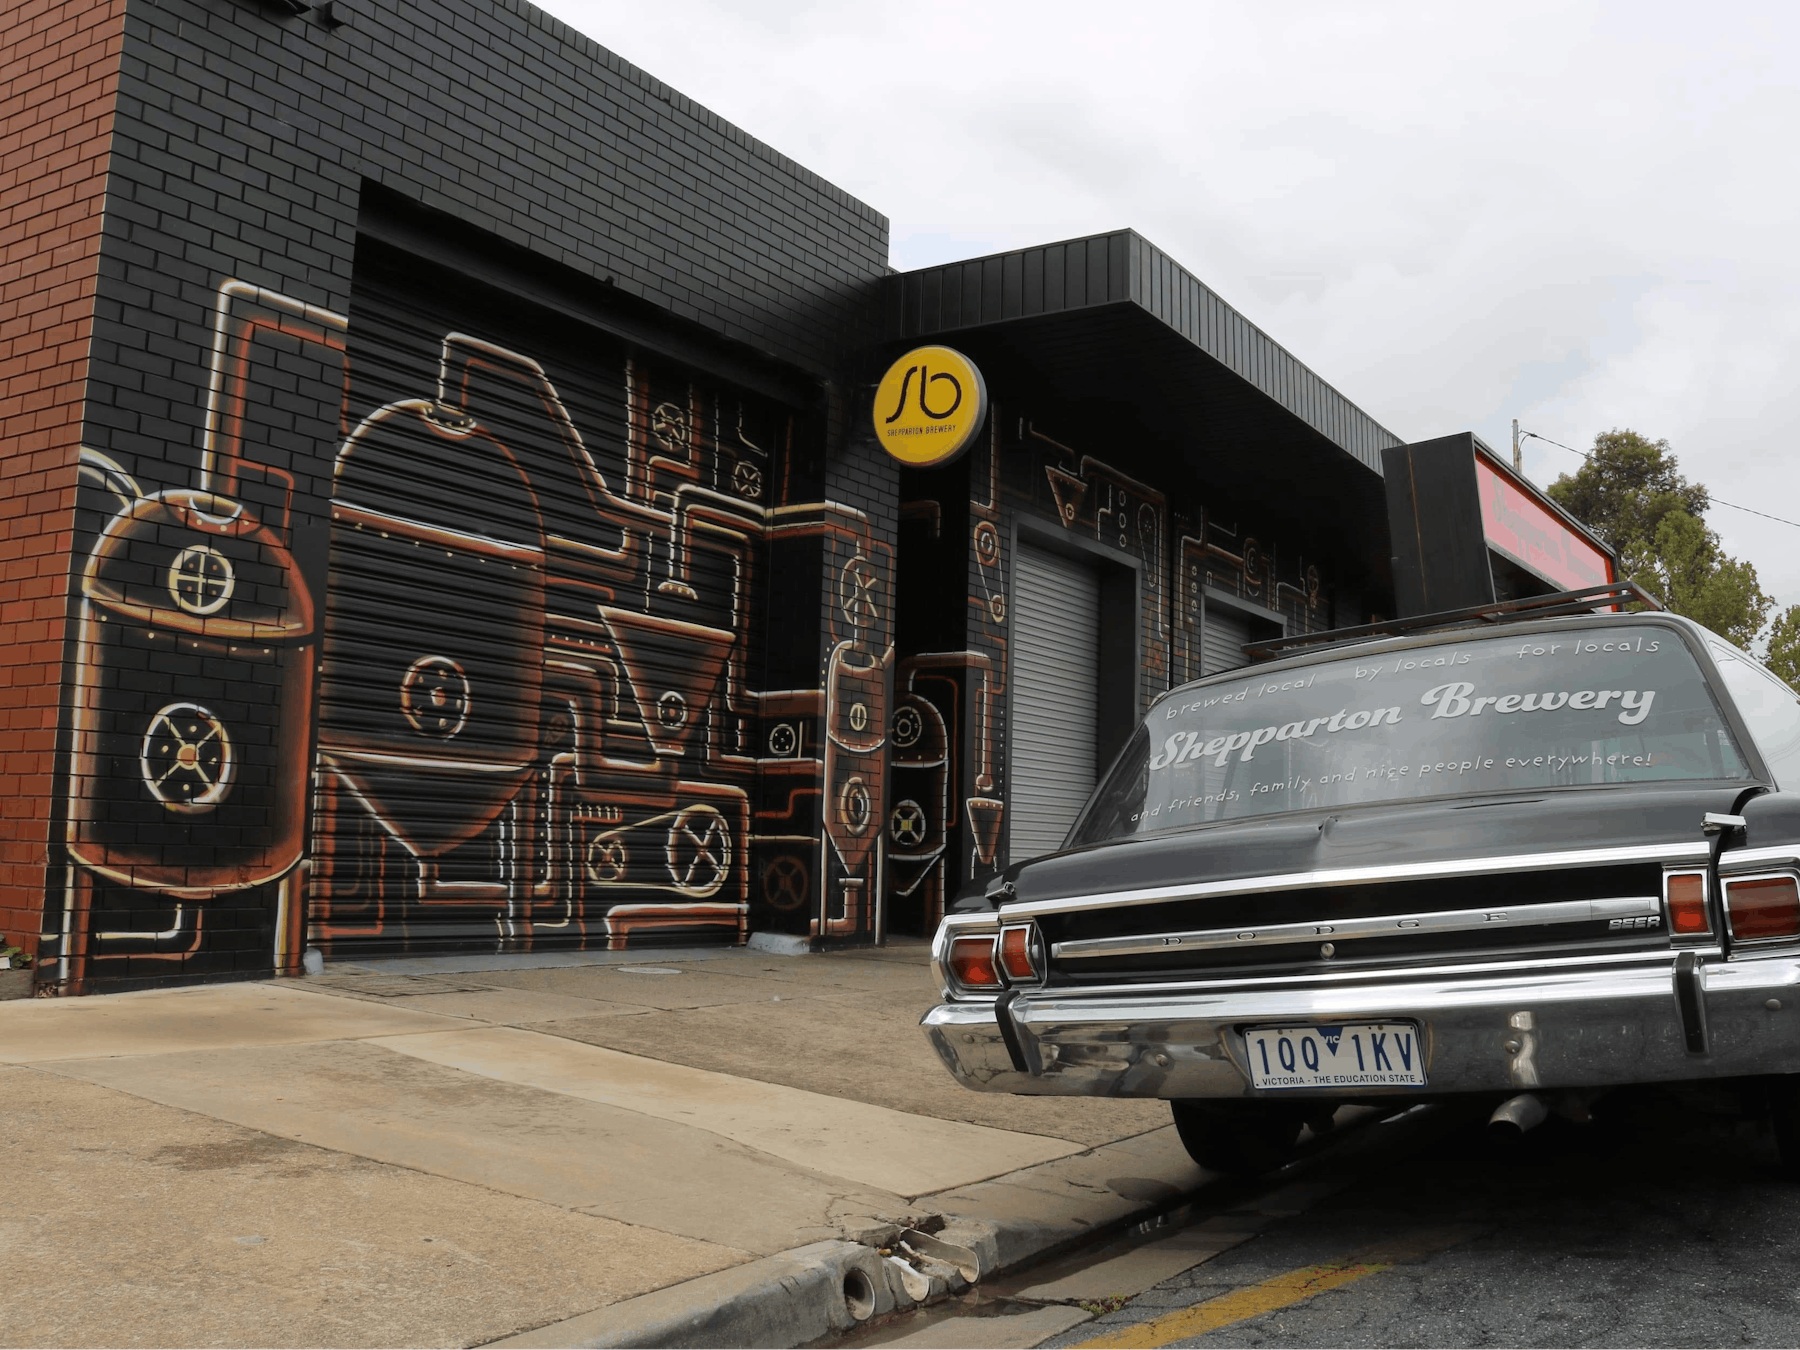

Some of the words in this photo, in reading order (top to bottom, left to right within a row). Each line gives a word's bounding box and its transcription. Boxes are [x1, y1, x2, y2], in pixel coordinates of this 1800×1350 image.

[887, 426, 923, 437] SHEPPARTON
[925, 424, 956, 435] BREWERY
[1166, 687, 1249, 720] brewed
[1258, 674, 1316, 698] local
[1355, 665, 1382, 682] by
[1395, 651, 1472, 674] locals
[1516, 643, 1561, 660] for
[1575, 637, 1660, 656] locals
[1149, 705, 1403, 771] Shepparton
[1420, 681, 1656, 726] Brewery
[1130, 806, 1162, 823] and
[1168, 789, 1240, 815] friends,
[1249, 775, 1312, 799] family
[1319, 765, 1357, 784] and
[1365, 764, 1410, 780] nice
[1419, 755, 1494, 779] people
[1505, 752, 1654, 772] everywhere!
[1608, 915, 1661, 931] BEER
[1322, 1035, 1340, 1045] VIC
[1351, 1033, 1412, 1072] 1KV
[1262, 1076, 1305, 1086] VICTORIA
[1313, 1075, 1332, 1085] THE
[1334, 1074, 1387, 1084] EDUCATION
[1389, 1073, 1416, 1084] STATE
